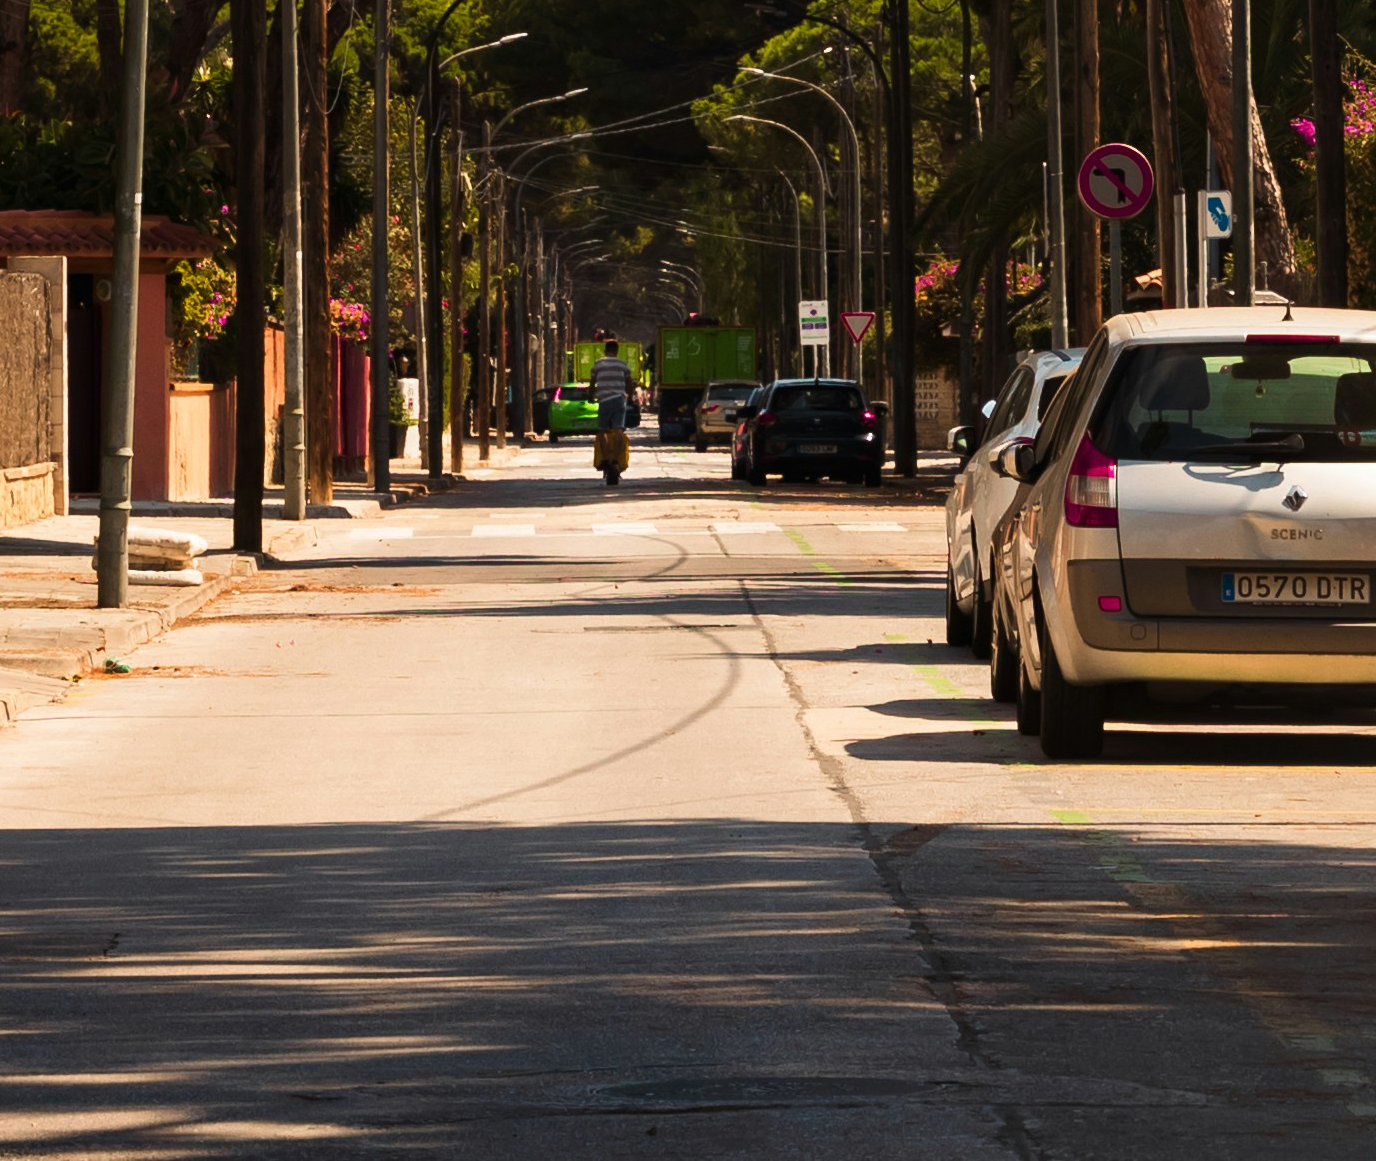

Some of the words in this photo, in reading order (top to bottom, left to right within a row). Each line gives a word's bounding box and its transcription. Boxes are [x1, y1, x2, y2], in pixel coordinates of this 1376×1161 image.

[1271, 529, 1323, 540] SCENIC
[1238, 576, 1307, 599] 0570
[1317, 577, 1366, 600] DTR
